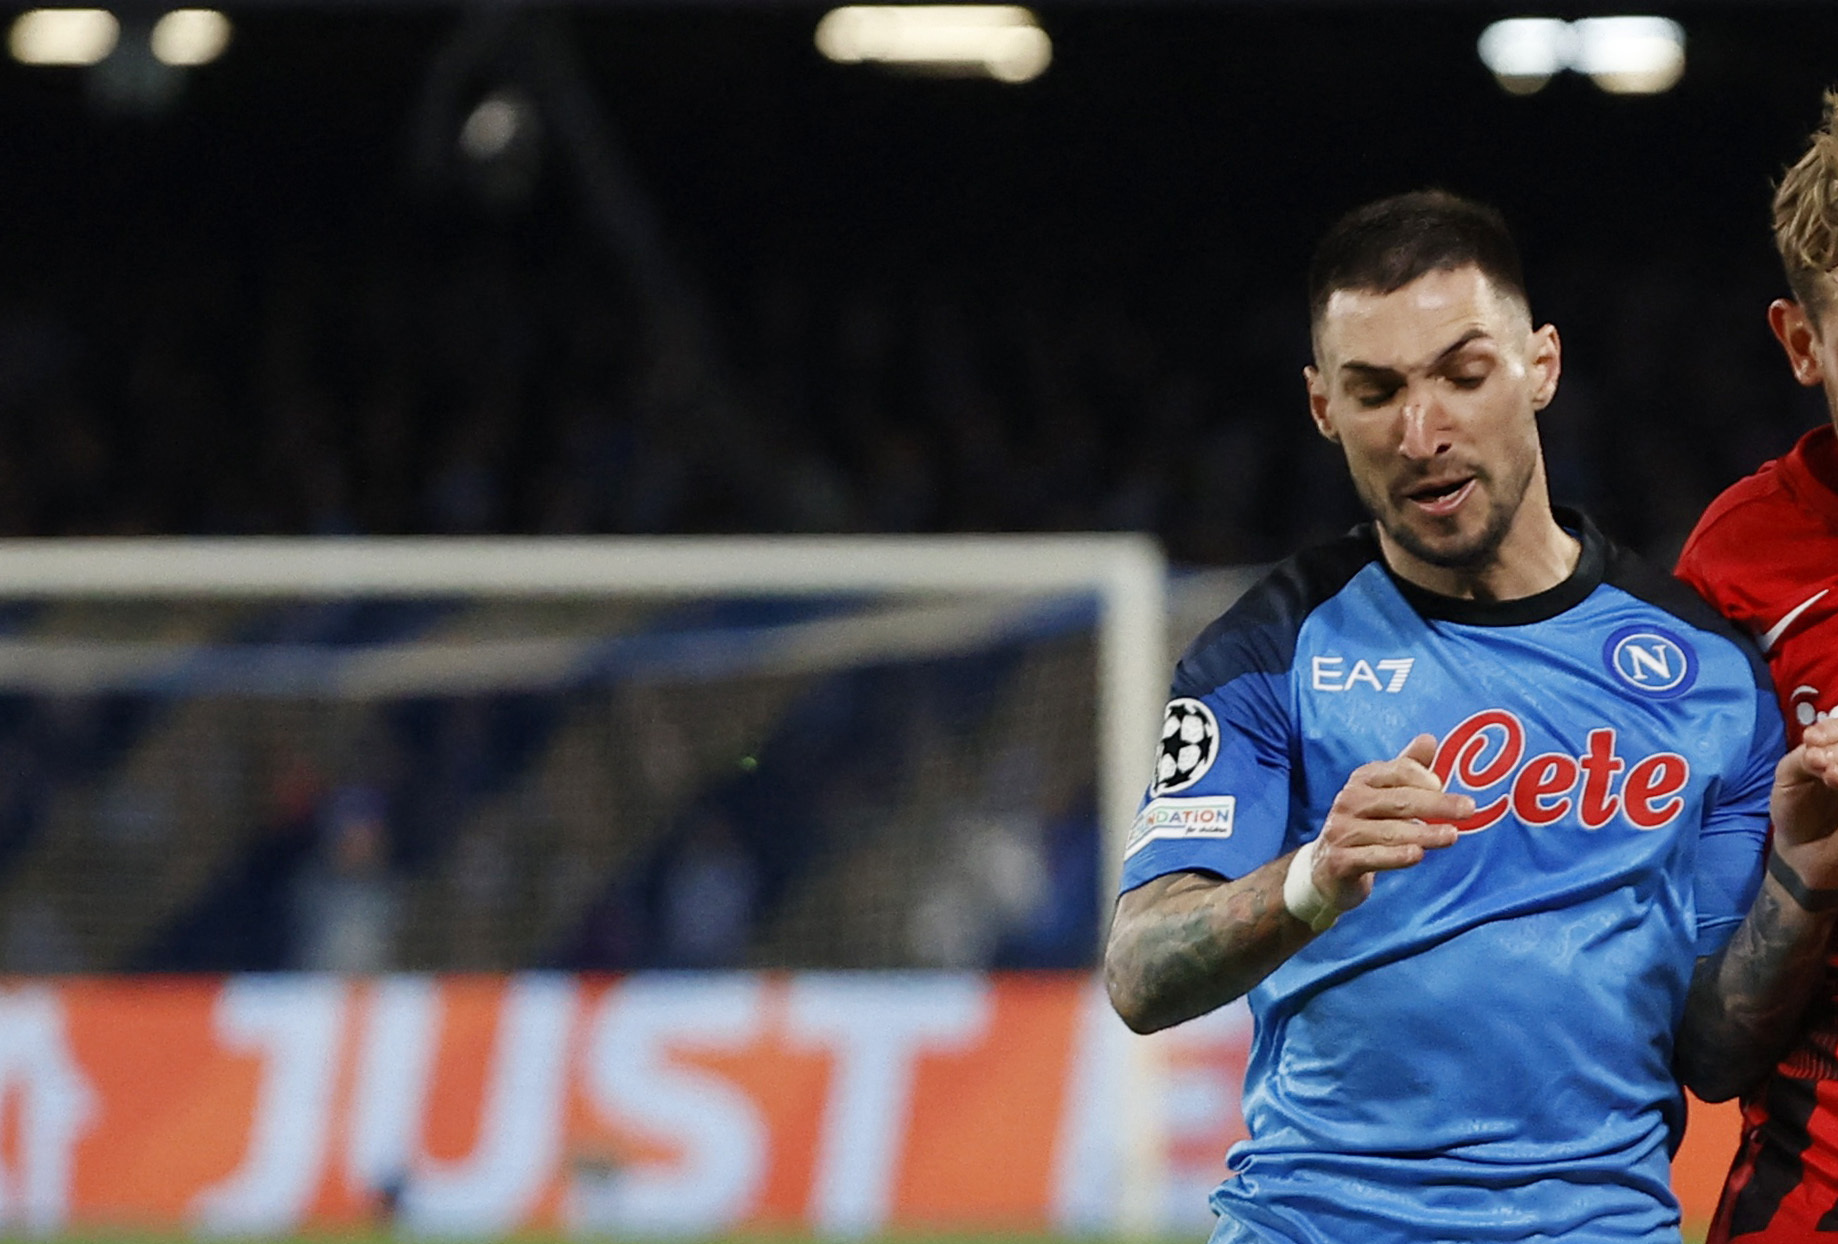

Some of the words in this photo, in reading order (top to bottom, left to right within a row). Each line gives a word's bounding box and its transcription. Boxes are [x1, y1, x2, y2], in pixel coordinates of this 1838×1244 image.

[1311, 655, 1415, 693] EA7
[1625, 643, 1671, 680] N
[187, 970, 992, 1240] JUST
